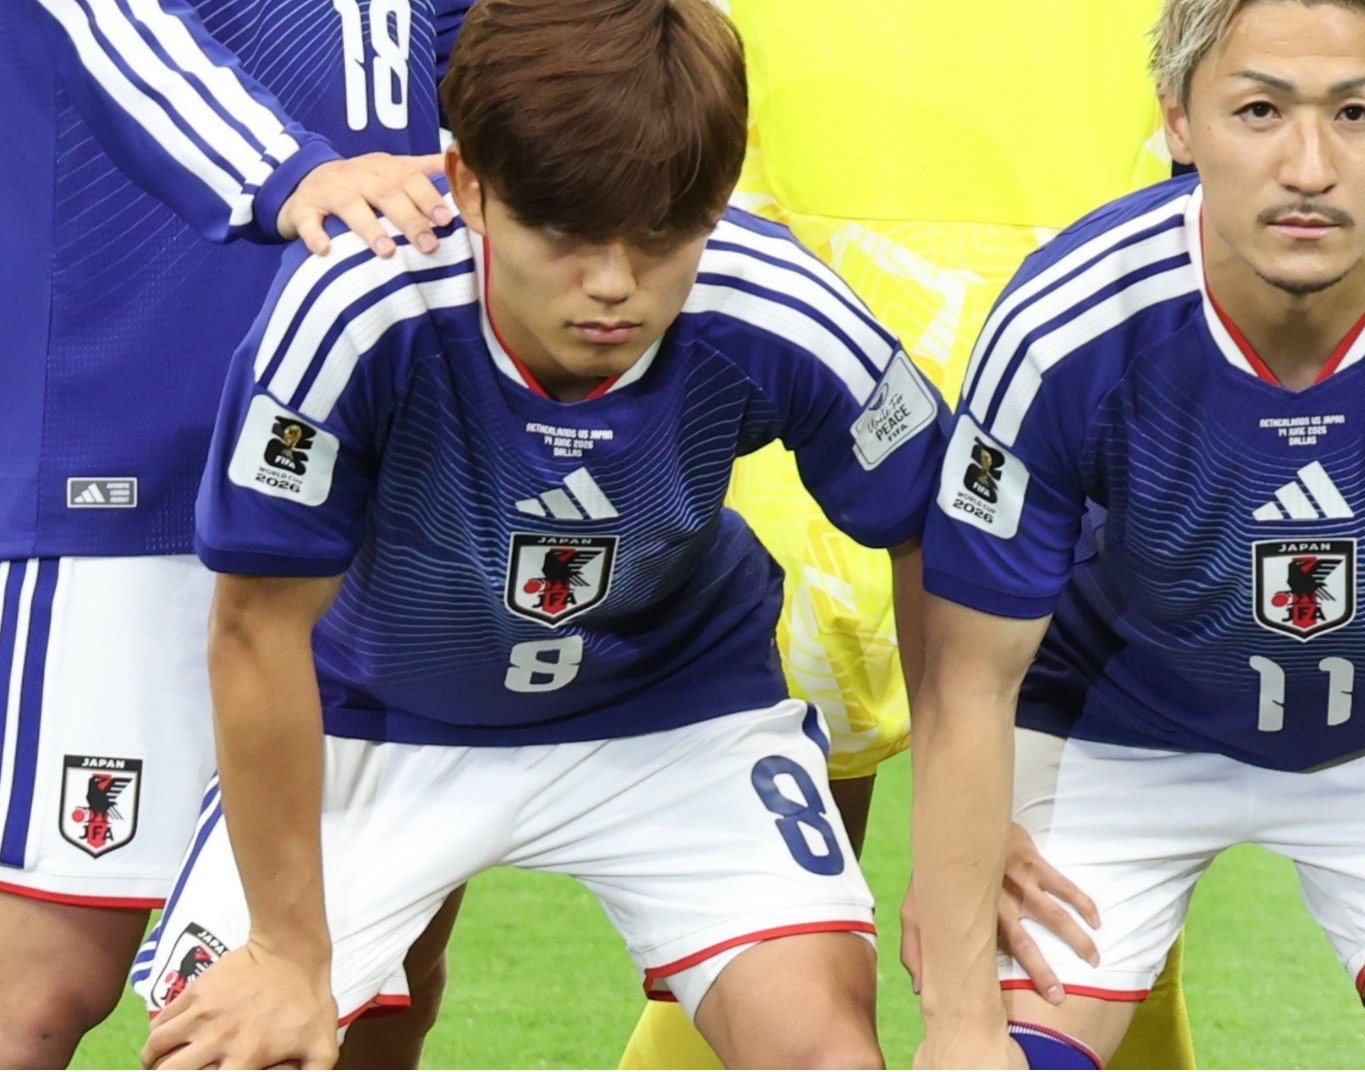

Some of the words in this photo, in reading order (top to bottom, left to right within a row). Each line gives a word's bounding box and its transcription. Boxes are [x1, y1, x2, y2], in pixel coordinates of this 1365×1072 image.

[875, 403, 911, 441] PEACE
[887, 423, 908, 442] FIFA
[1289, 436, 1317, 446] DALLAS
[554, 447, 582, 457] DALLAS
[274, 455, 296, 469] FIFA
[255, 473, 300, 493] 2026
[972, 482, 990, 498] FIFA
[953, 499, 993, 524] 2026
[537, 536, 592, 545] JAPAN
[1278, 543, 1331, 552] JAPAN
[531, 593, 577, 608] JFA
[1281, 608, 1327, 622] JFA
[504, 634, 583, 693] 8
[1249, 655, 1354, 732] 11
[81, 757, 125, 769] JAPAN
[751, 755, 844, 876] 8
[78, 825, 114, 841] JFA
